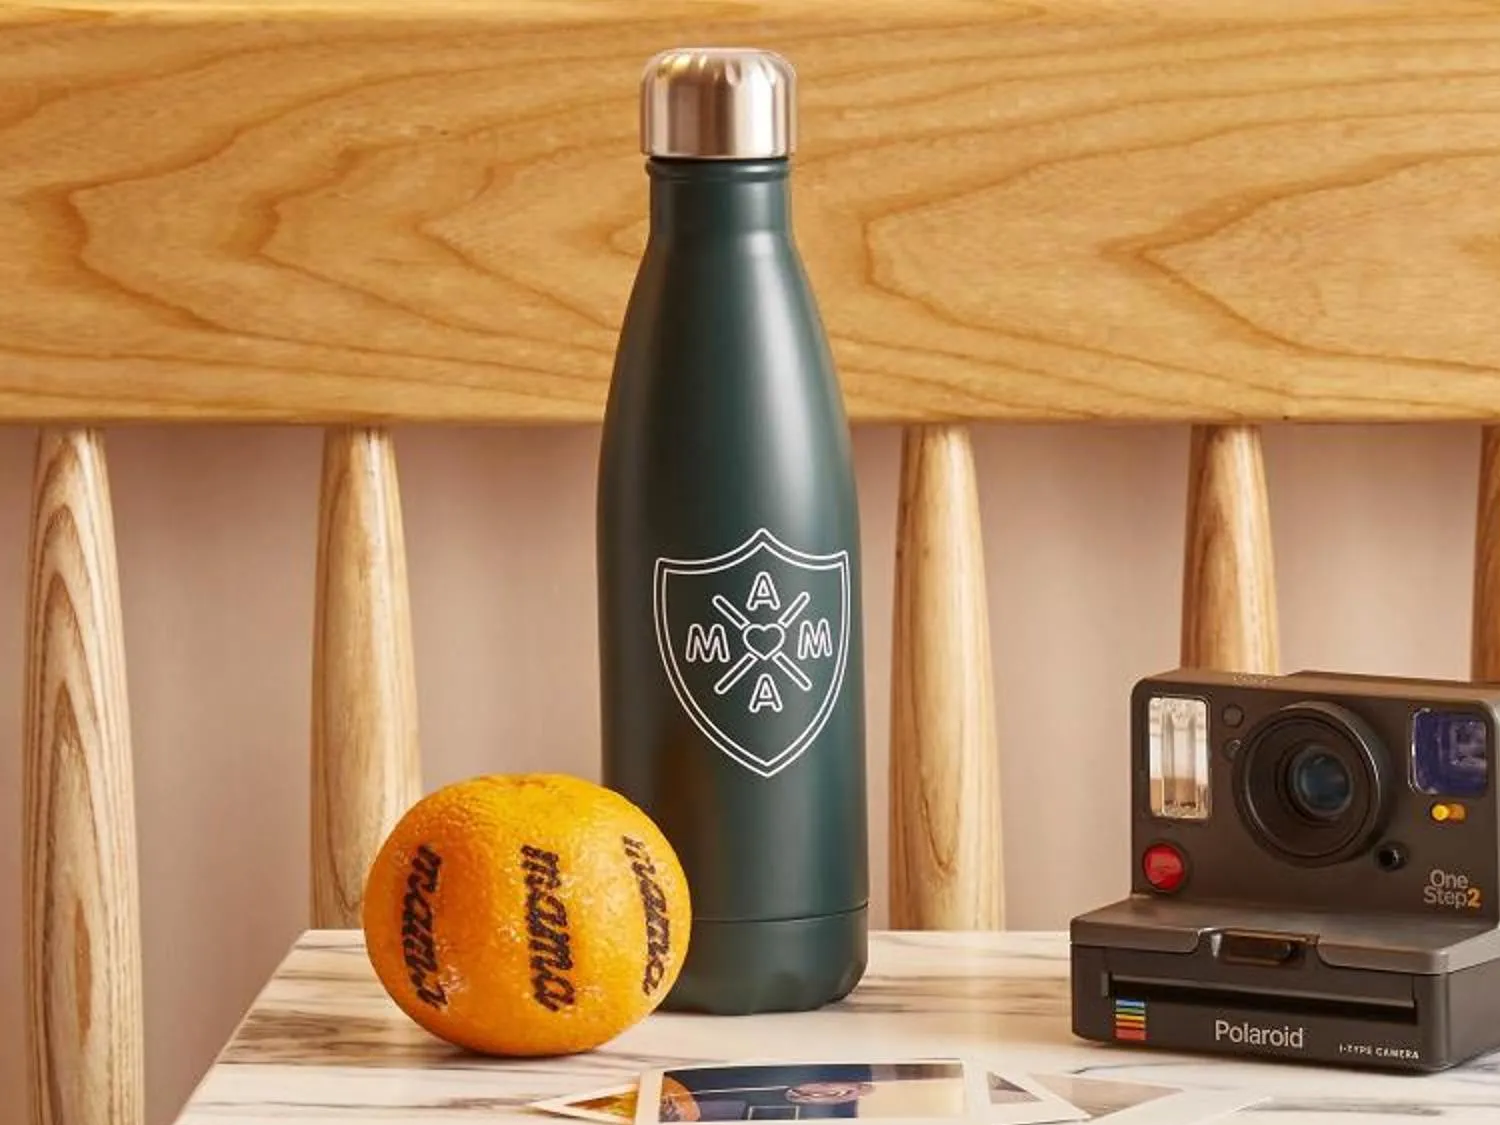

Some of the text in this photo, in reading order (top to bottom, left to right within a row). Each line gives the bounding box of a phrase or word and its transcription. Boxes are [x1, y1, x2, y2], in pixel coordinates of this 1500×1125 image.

[746, 571, 781, 611] A
[685, 618, 833, 662] M M
[749, 673, 783, 713] A
[1423, 886, 1481, 909] Step2
[1430, 869, 1469, 889] One
[402, 844, 449, 1011] mama
[520, 844, 577, 1013] mama
[622, 835, 671, 998] mama
[1215, 1019, 1304, 1049] Polaroid
[1375, 1047, 1420, 1060] CAMERA
